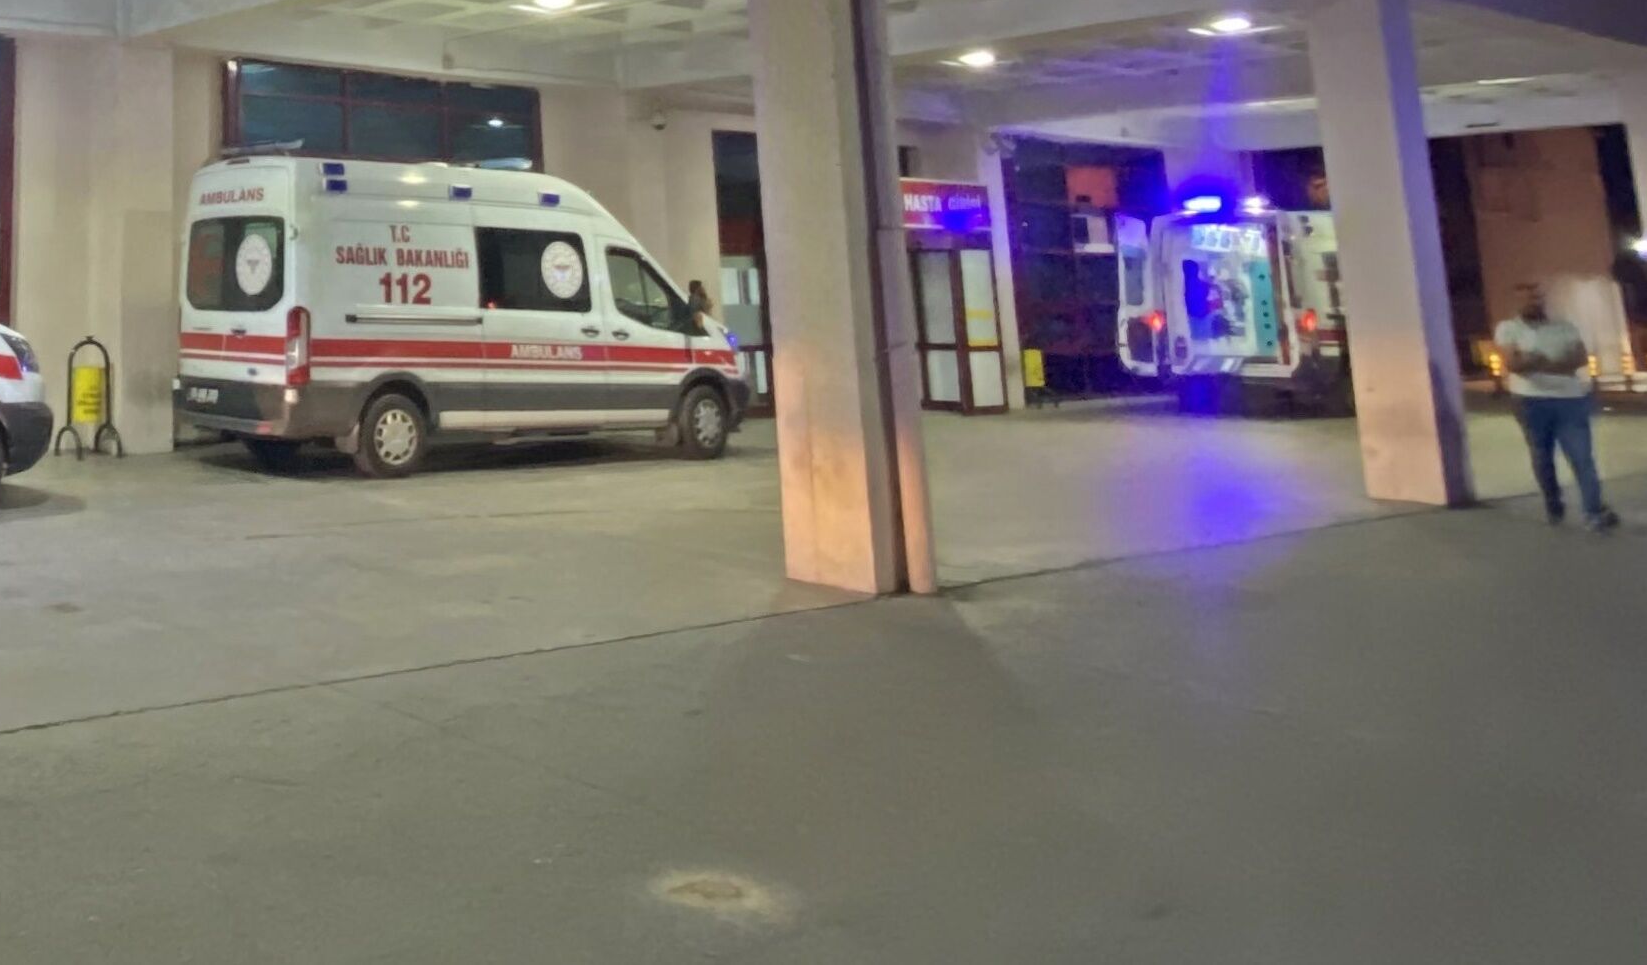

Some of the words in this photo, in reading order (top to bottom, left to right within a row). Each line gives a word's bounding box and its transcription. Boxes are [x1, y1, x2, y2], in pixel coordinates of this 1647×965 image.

[199, 187, 265, 206] AMBULANS
[335, 243, 387, 266] SAĞLIK
[395, 247, 470, 269] BAKANLIĞI
[378, 272, 432, 305] 112
[511, 343, 583, 361] AMBULANS
